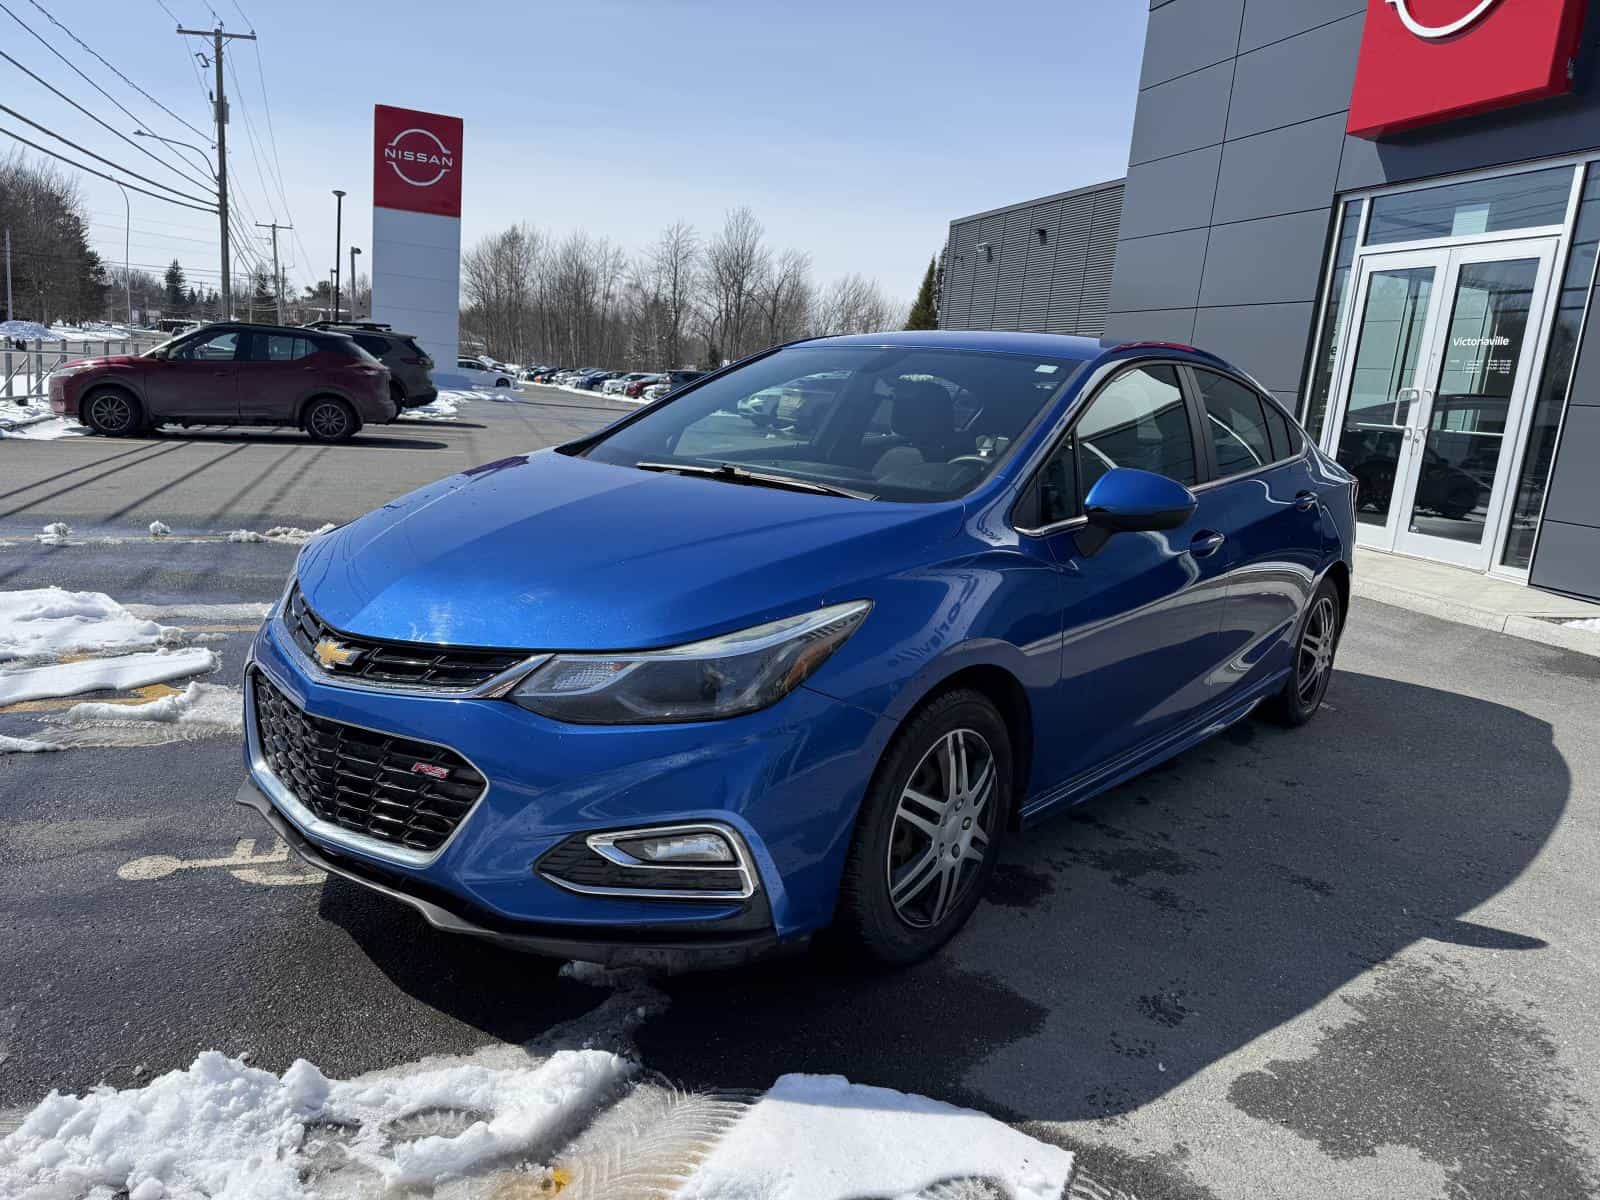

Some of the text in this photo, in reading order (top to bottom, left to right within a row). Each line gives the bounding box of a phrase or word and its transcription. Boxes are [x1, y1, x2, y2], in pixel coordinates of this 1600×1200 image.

[384, 147, 453, 167] NISSAN
[1453, 335, 1510, 346] Victoriaville
[410, 761, 449, 779] RS
